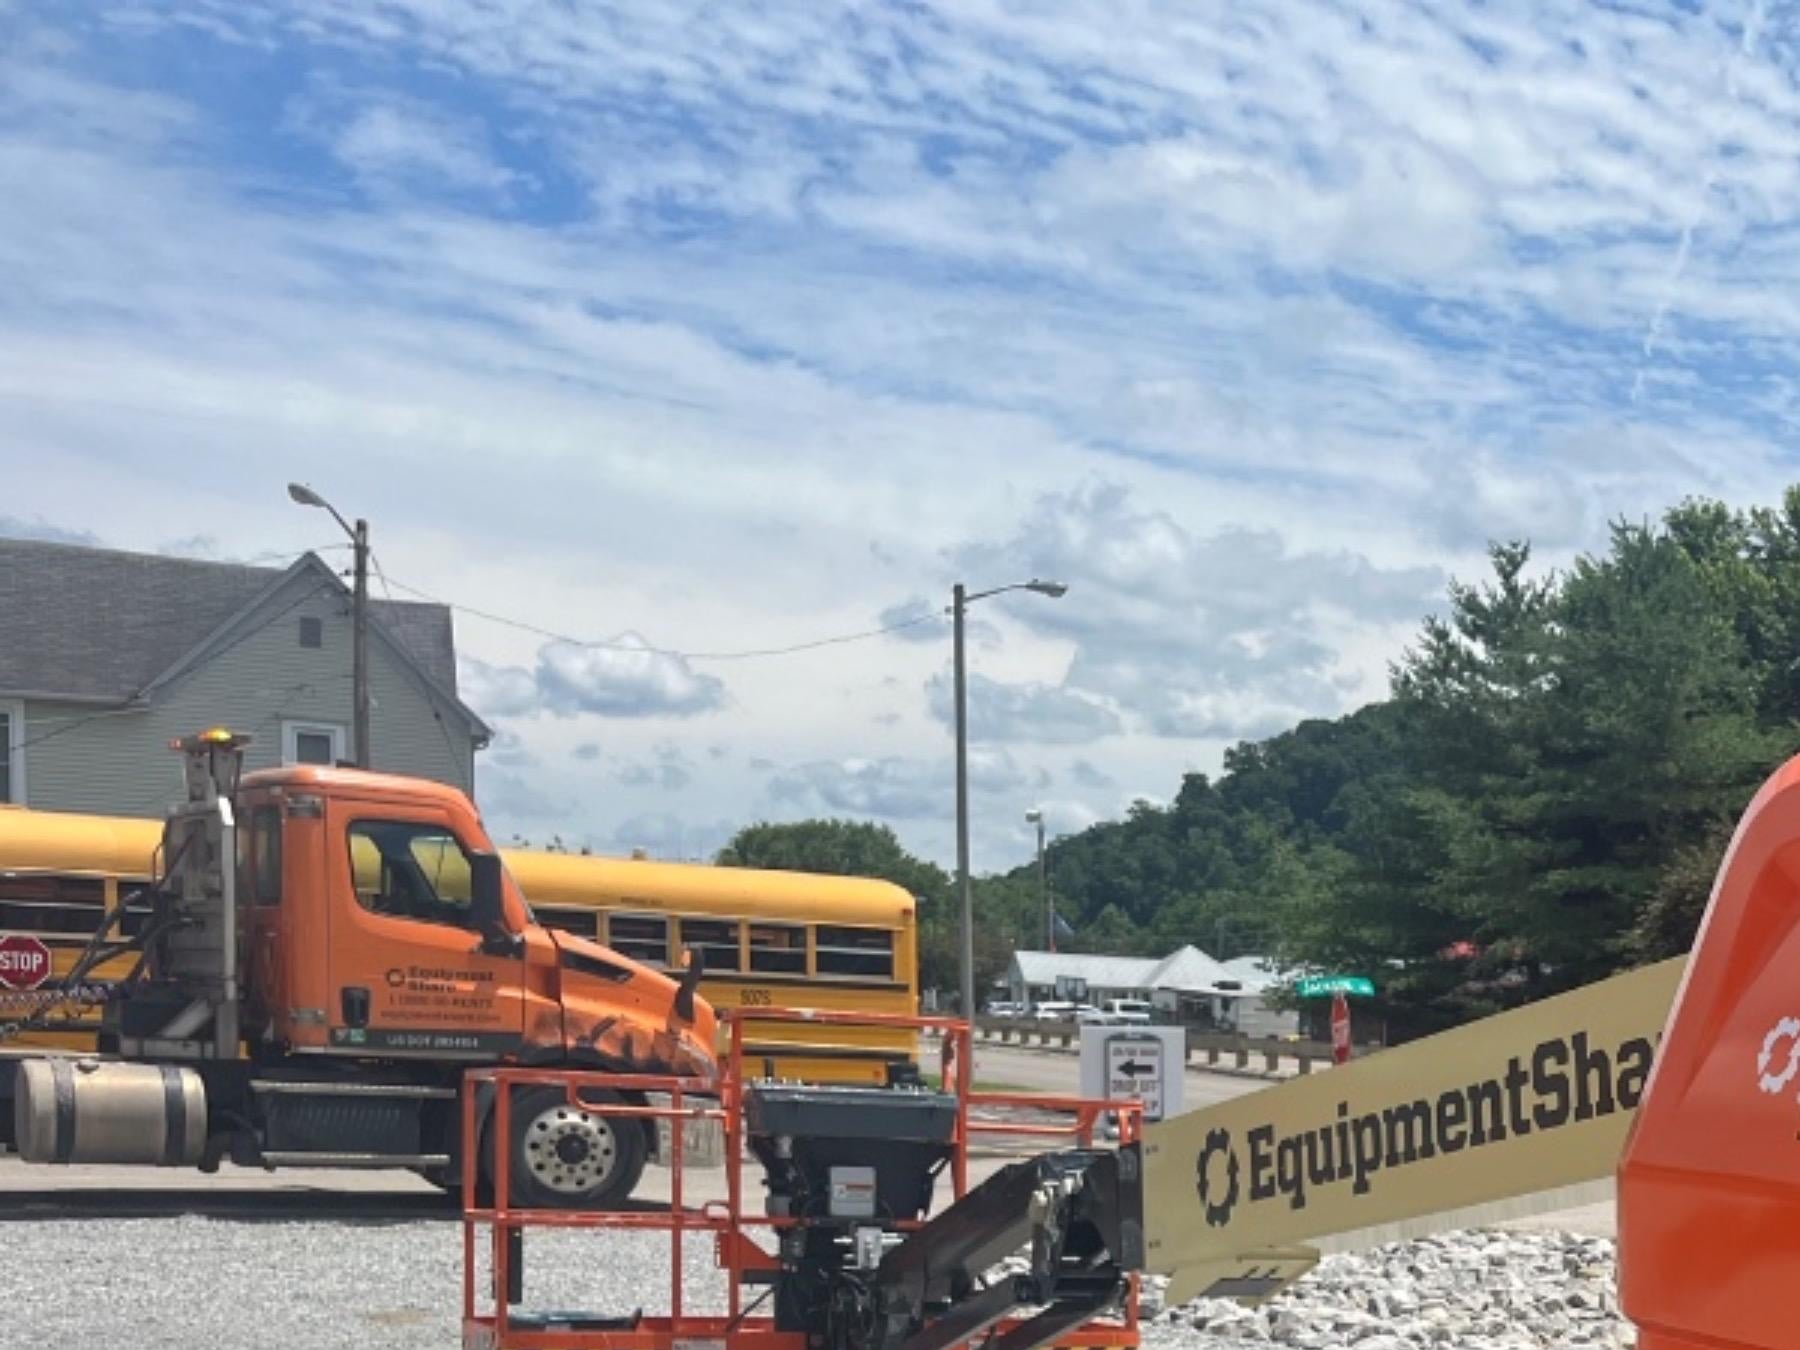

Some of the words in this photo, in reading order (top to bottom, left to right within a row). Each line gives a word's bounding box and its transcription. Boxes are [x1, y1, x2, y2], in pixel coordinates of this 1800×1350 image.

[0, 951, 43, 973] STOP
[408, 965, 494, 982] Equipment
[408, 981, 457, 994] Share
[1247, 1031, 1662, 1210] EquipmentSha
